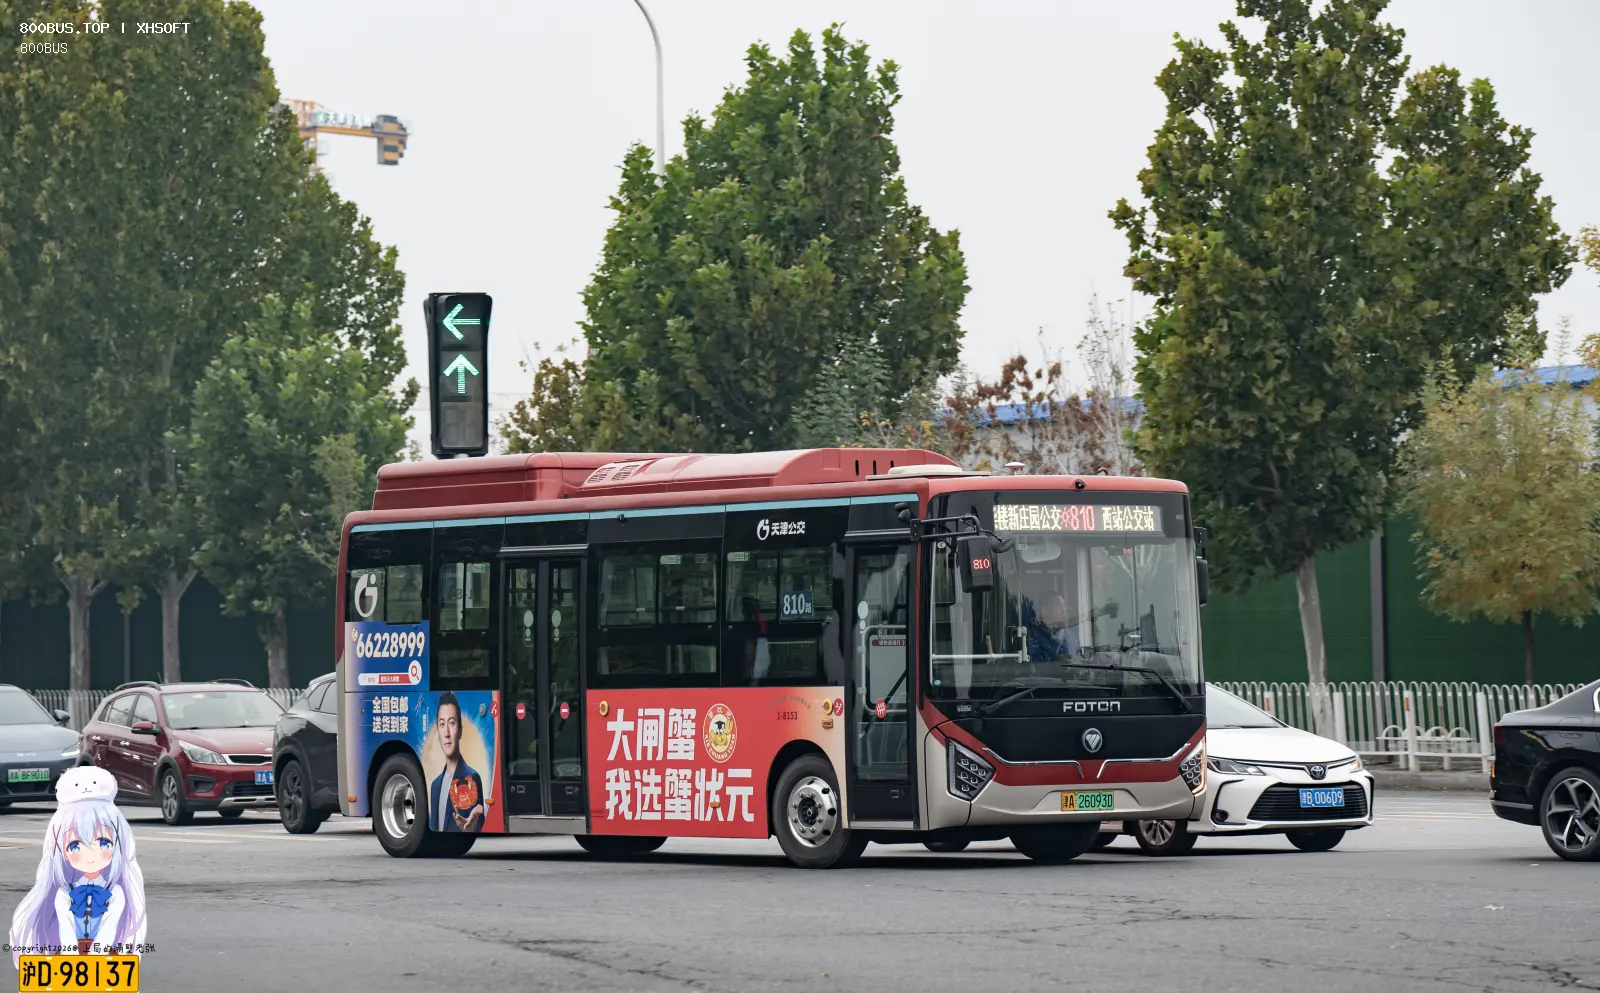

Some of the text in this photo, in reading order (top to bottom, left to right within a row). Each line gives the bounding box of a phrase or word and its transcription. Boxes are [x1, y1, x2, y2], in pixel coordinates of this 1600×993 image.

[1070, 505, 1095, 531] 810
[1102, 505, 1154, 531] 西站公交站
[771, 521, 806, 536] 天津公交
[973, 558, 990, 570] 810
[783, 594, 812, 615] 810路
[356, 631, 425, 658] 66228999
[372, 695, 409, 714] 全国包邮
[1063, 701, 1121, 713] FOTON
[777, 711, 798, 720] 1-8153
[372, 716, 409, 734] 送货到家
[606, 708, 697, 761] 大闸蟹
[605, 768, 755, 822] 我选蟹状元
[1079, 794, 1113, 808] 26093D
